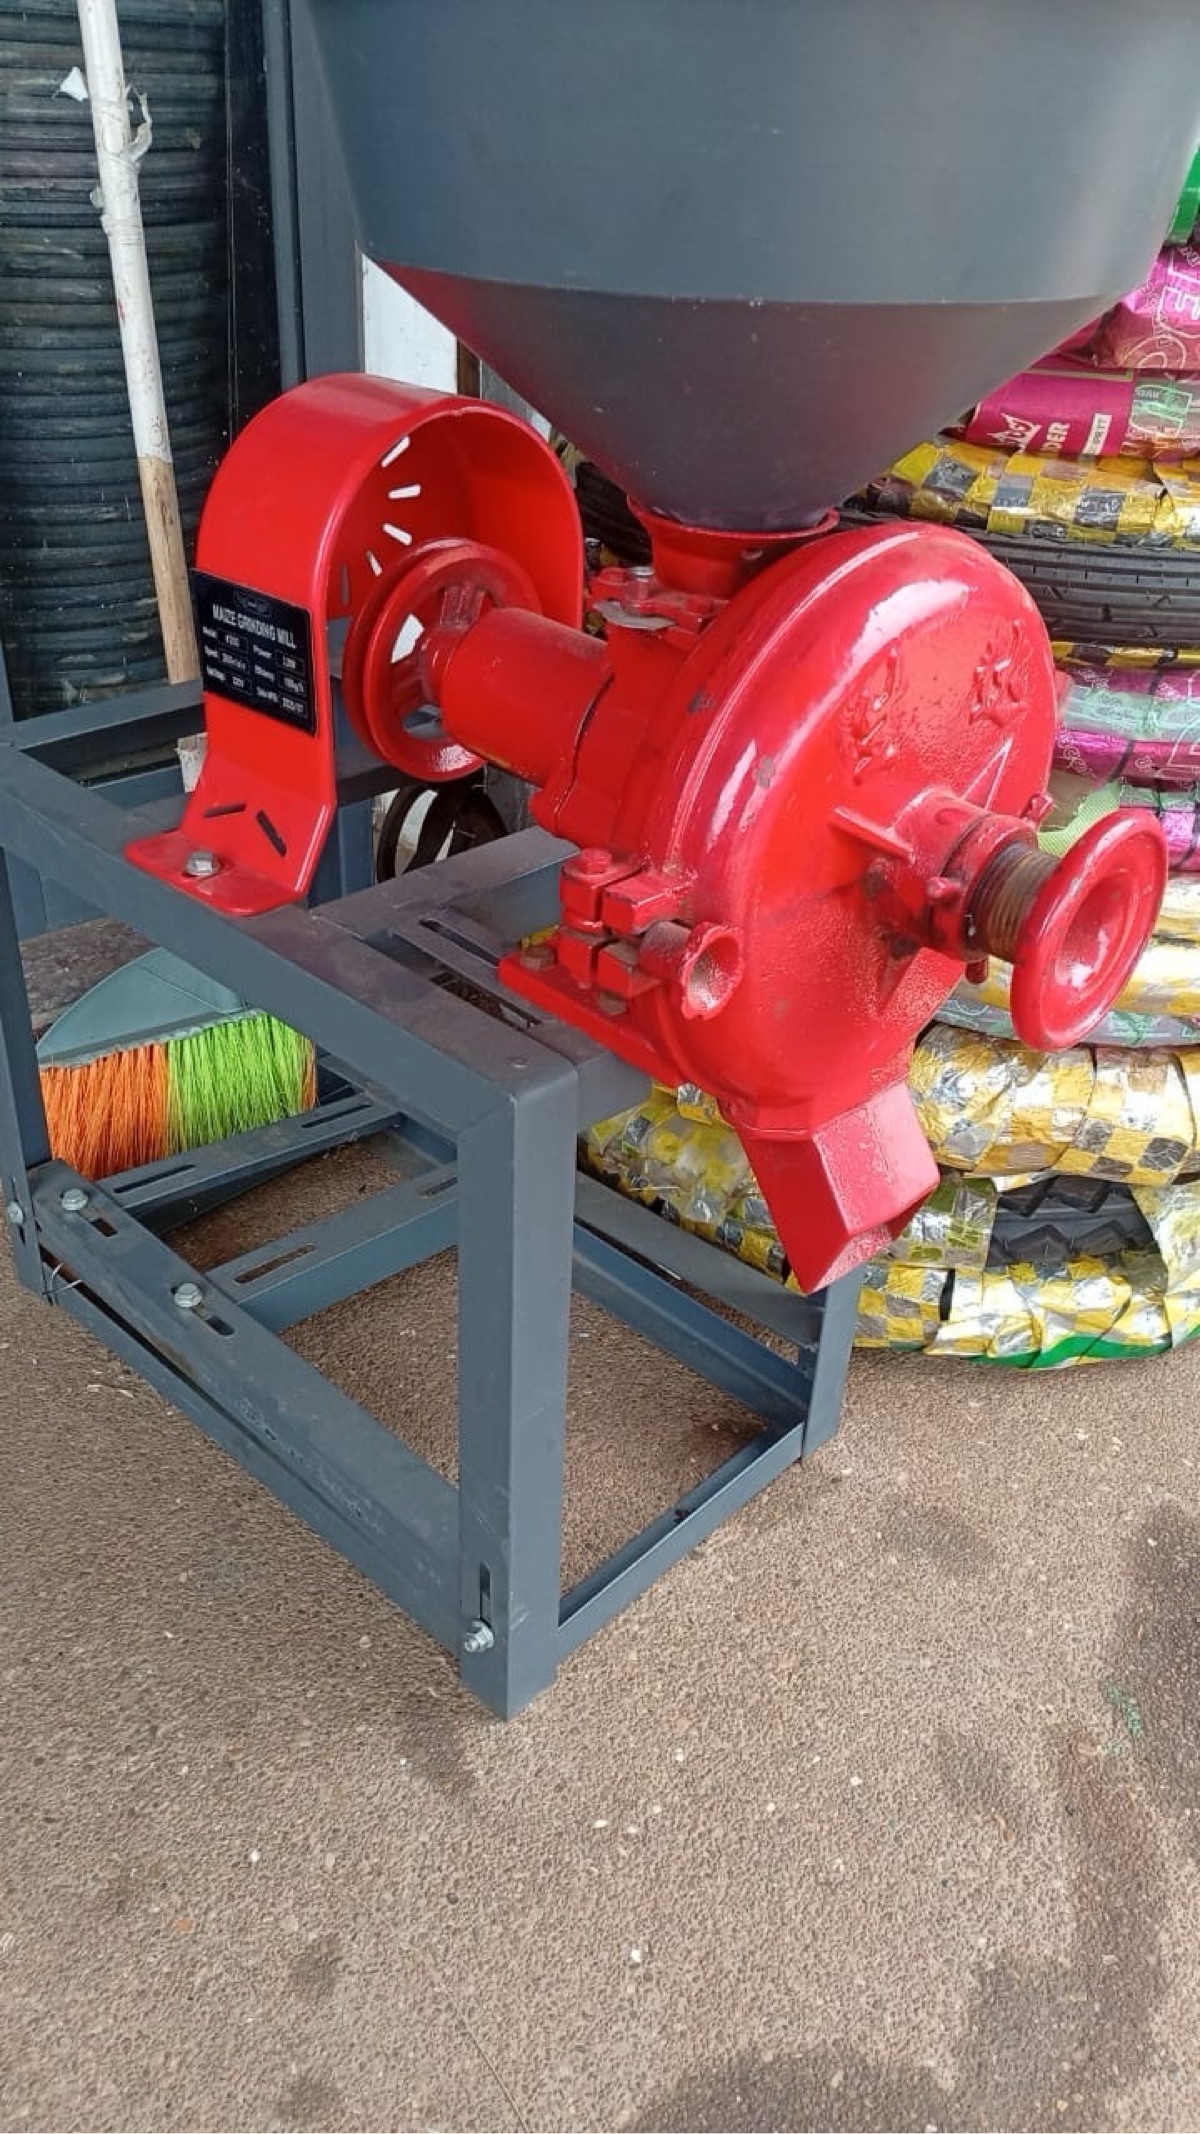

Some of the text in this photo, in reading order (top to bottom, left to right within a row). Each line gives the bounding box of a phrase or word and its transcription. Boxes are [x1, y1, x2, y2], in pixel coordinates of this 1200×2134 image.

[212, 603, 237, 628] MAIZE
[237, 613, 276, 641] GRINDING
[276, 627, 298, 649] MILL
